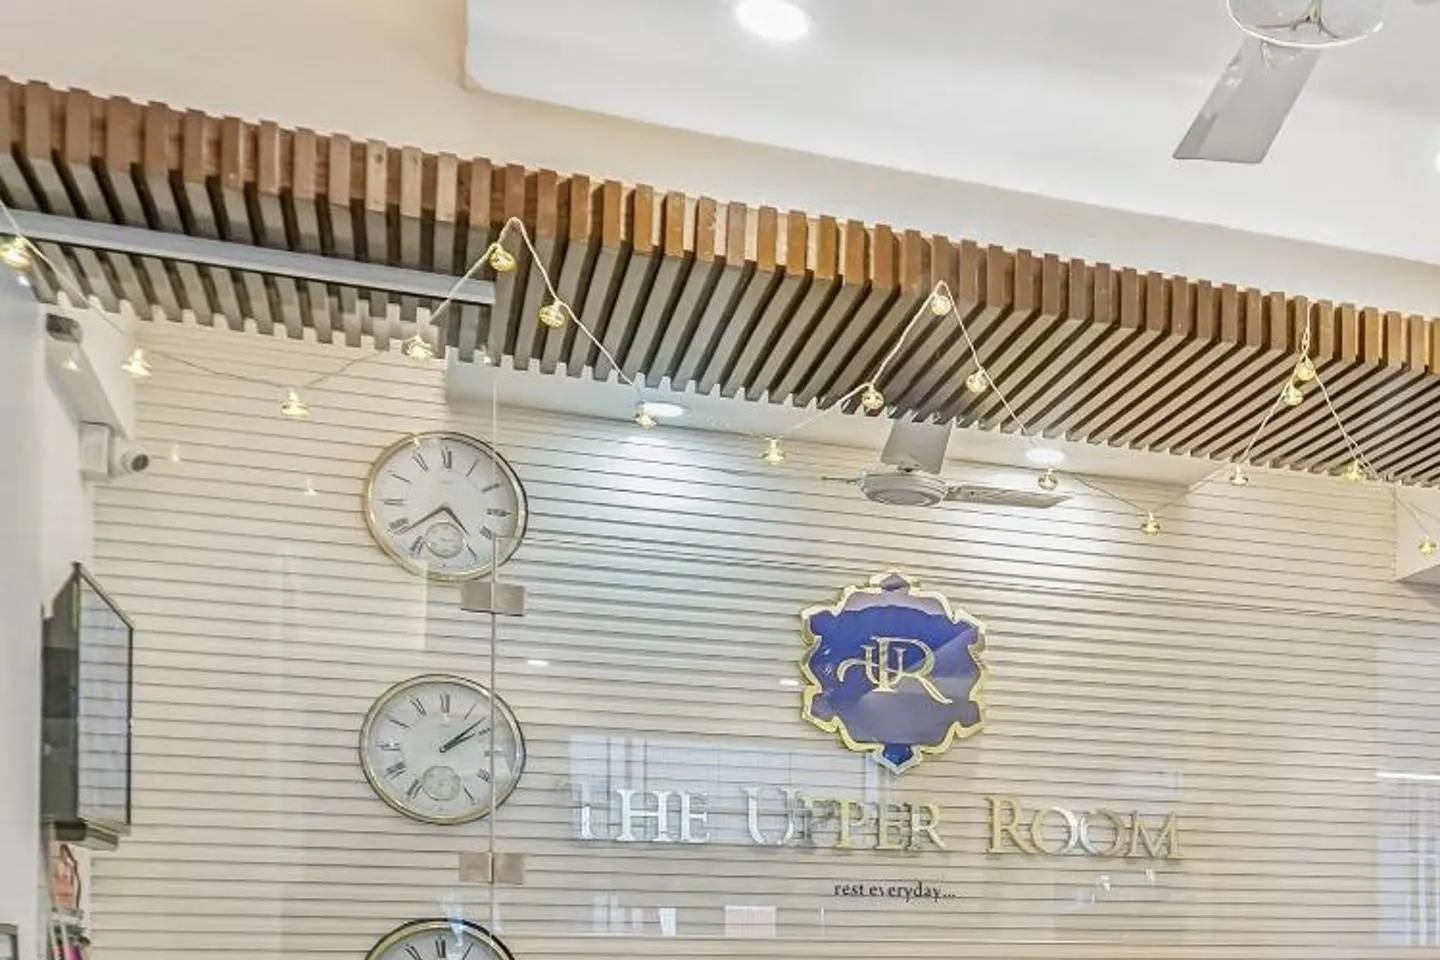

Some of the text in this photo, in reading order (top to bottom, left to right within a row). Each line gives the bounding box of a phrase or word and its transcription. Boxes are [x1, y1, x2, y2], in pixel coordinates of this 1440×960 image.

[741, 786, 946, 852] UPPER
[985, 796, 1185, 858] ROOM
[833, 883, 864, 897] rest
